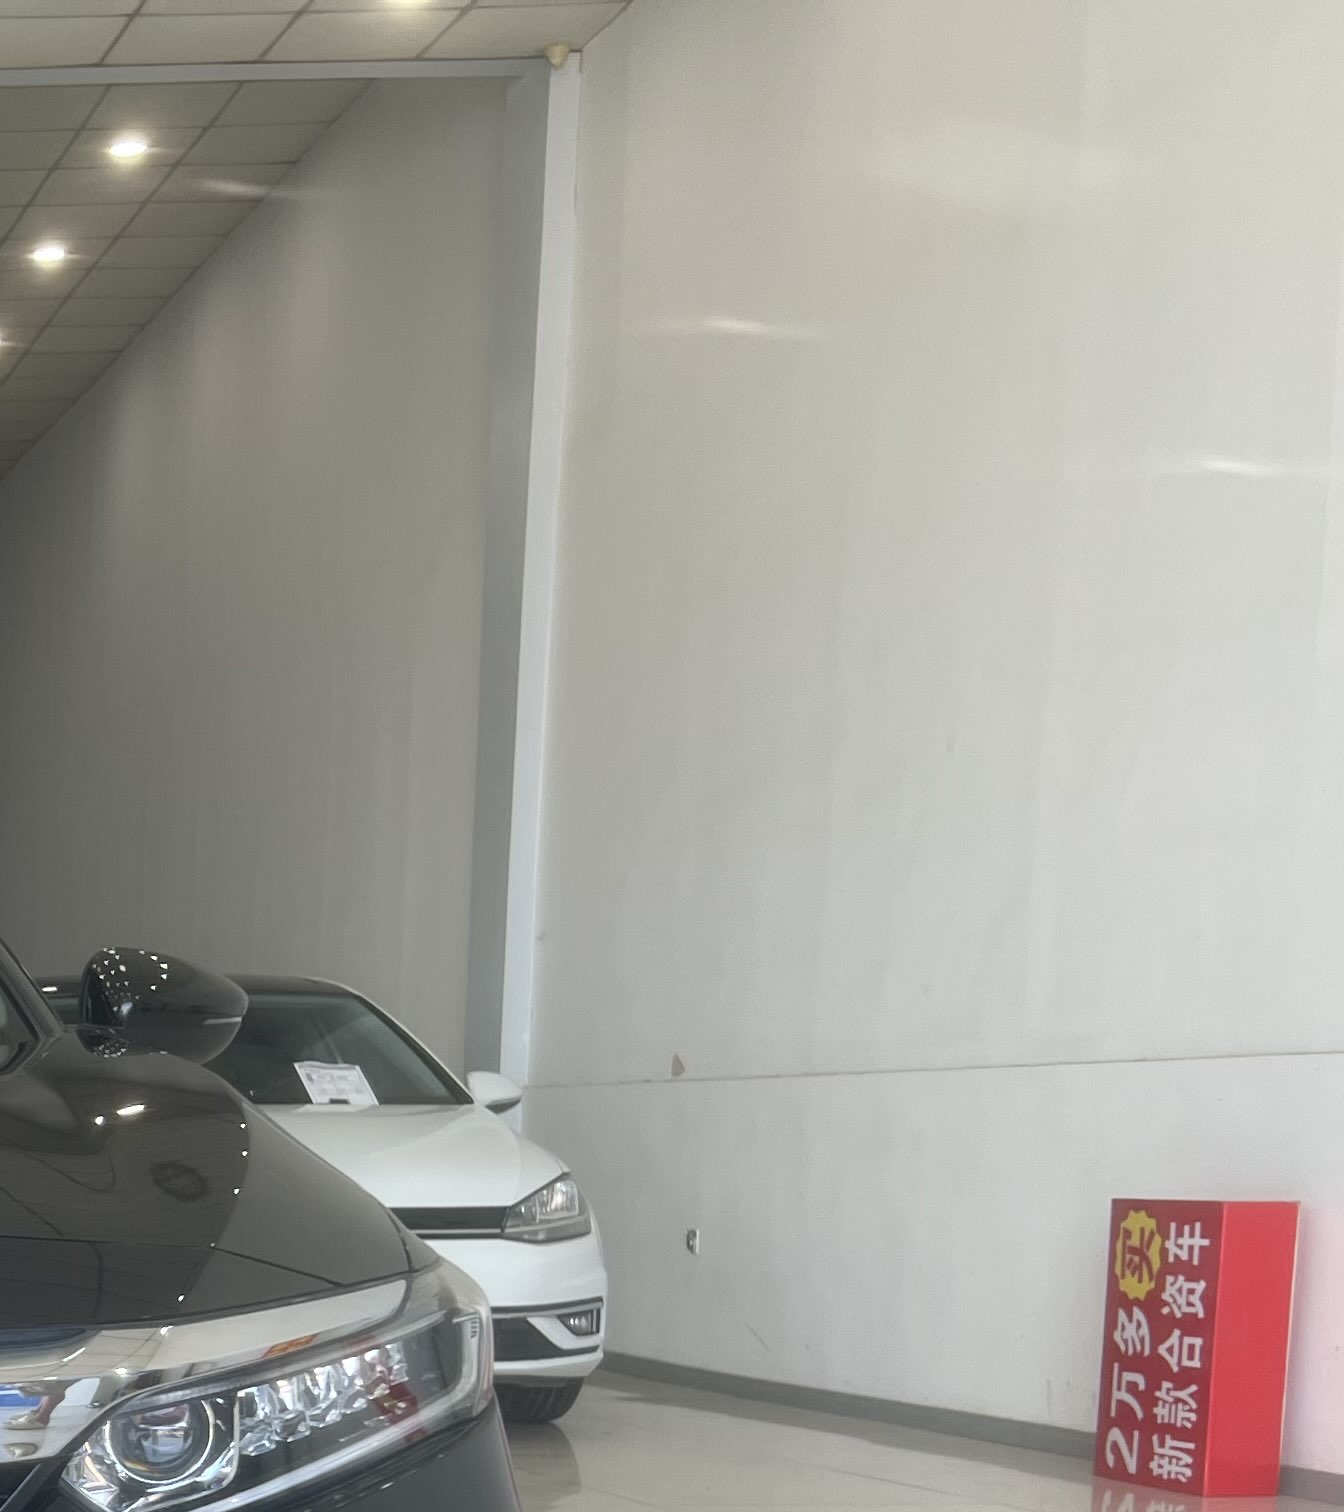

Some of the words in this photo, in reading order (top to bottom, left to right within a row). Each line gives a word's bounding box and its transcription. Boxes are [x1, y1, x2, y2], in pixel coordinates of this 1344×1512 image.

[1149, 1221, 1211, 1483] 新款合资车
